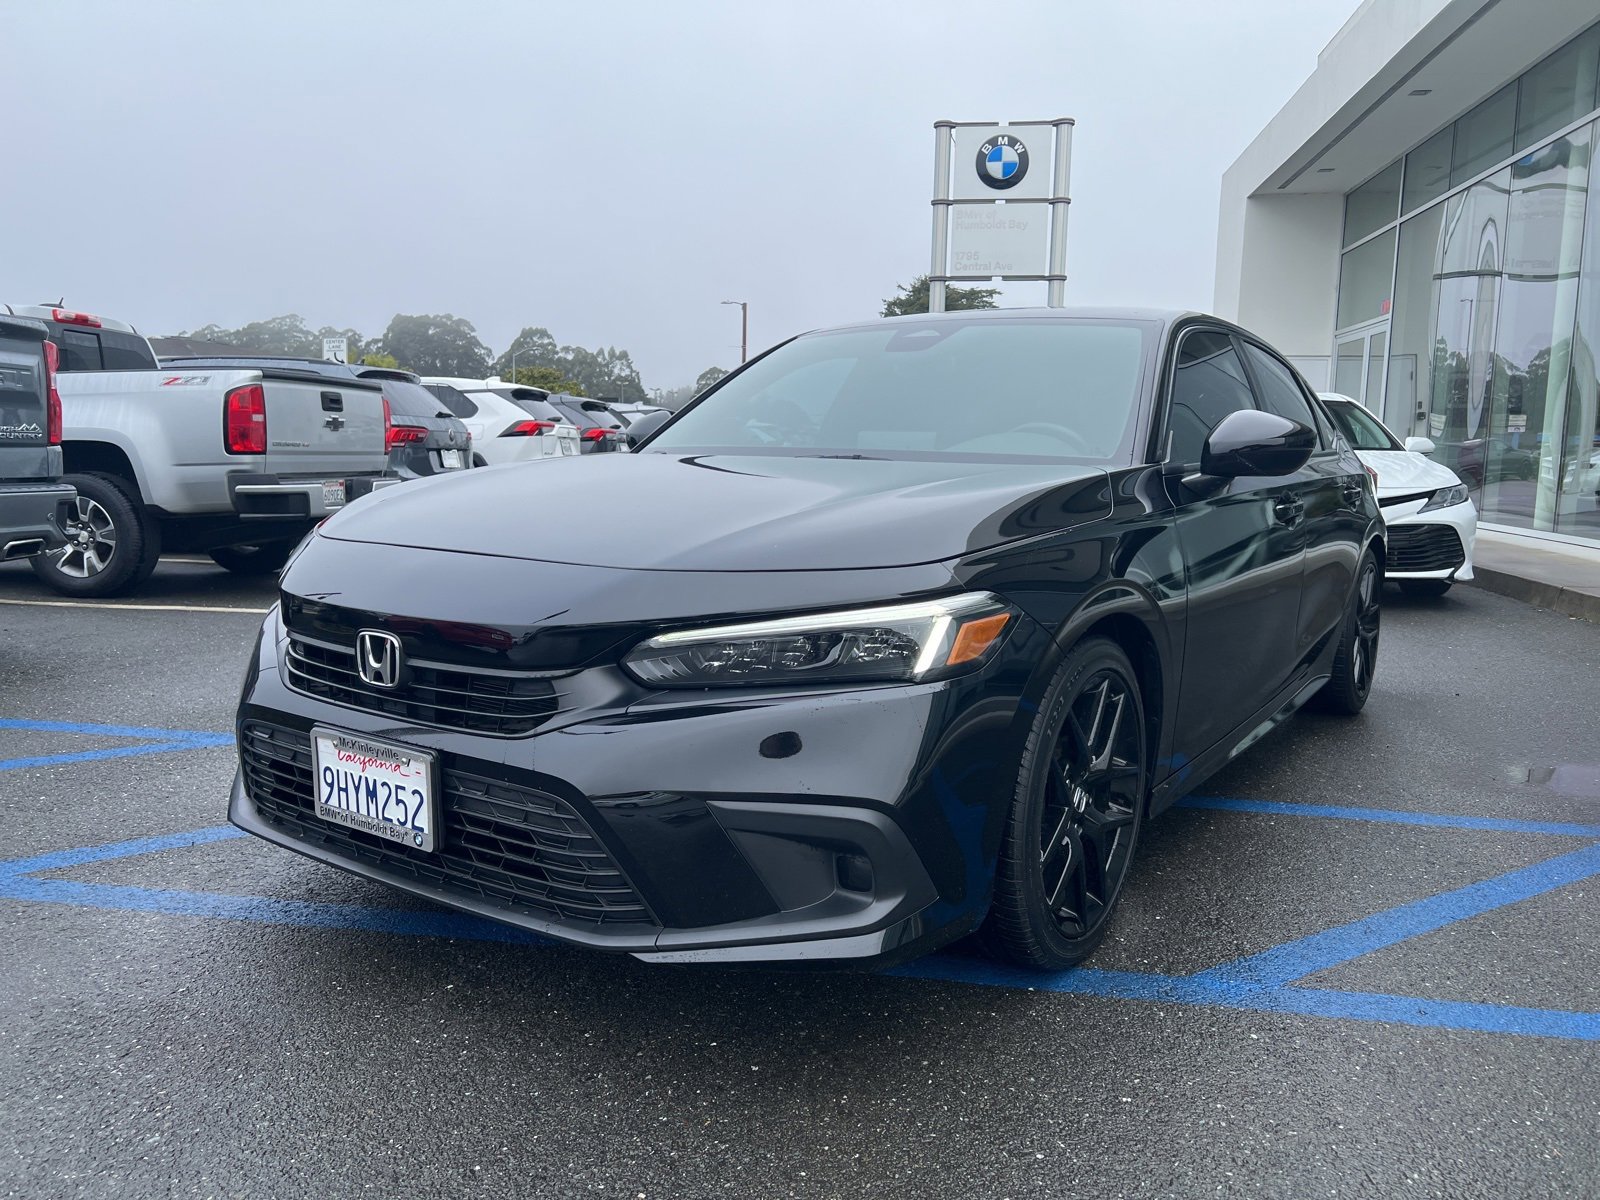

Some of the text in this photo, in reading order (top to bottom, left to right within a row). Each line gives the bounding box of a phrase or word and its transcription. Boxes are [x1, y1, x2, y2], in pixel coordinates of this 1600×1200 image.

[981, 136, 1025, 154] BMW
[956, 209, 998, 219] BMW of
[955, 219, 1029, 230] Humboldt Bay
[955, 251, 979, 261] 1795
[954, 262, 1013, 271] Central Ave
[339, 737, 399, 760] McKinleyville
[337, 750, 410, 777] California
[323, 766, 424, 833] 9HYM252
[340, 813, 348, 823] of
[350, 816, 387, 834] Humboldt
